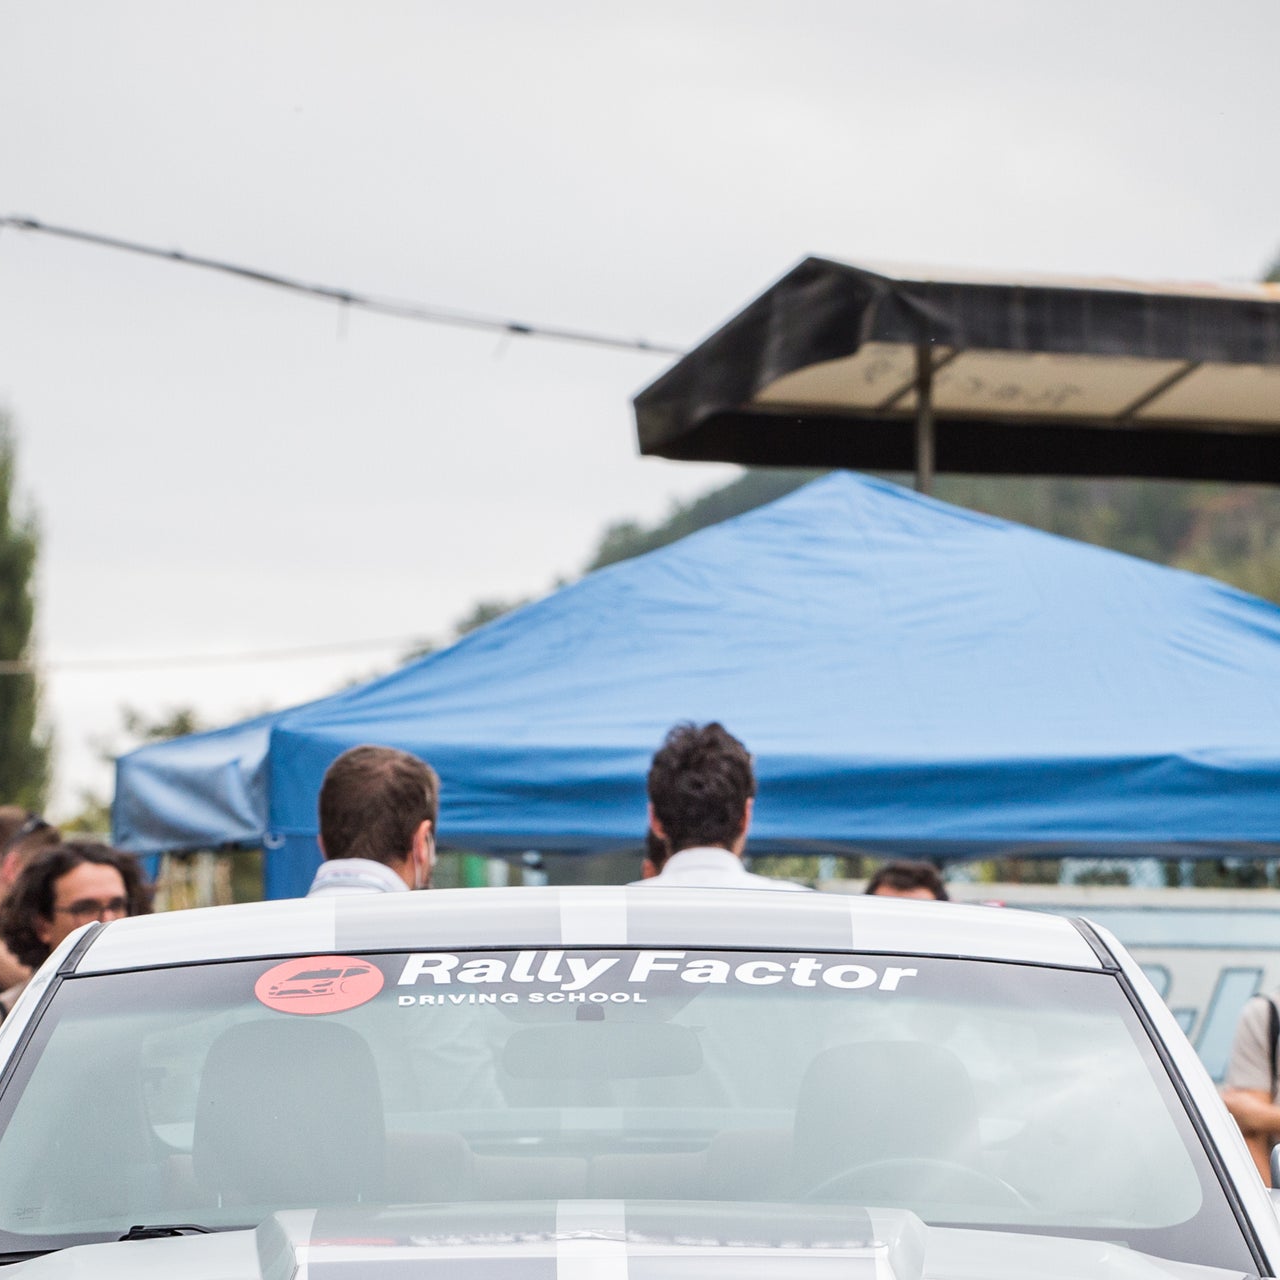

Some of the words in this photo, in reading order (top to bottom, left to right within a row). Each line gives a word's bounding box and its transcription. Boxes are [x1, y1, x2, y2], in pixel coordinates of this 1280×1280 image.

[397, 951, 620, 991] Rally
[628, 951, 918, 991] Factor
[398, 993, 518, 1006] DRIVING
[528, 992, 647, 1003] SCHOOL
